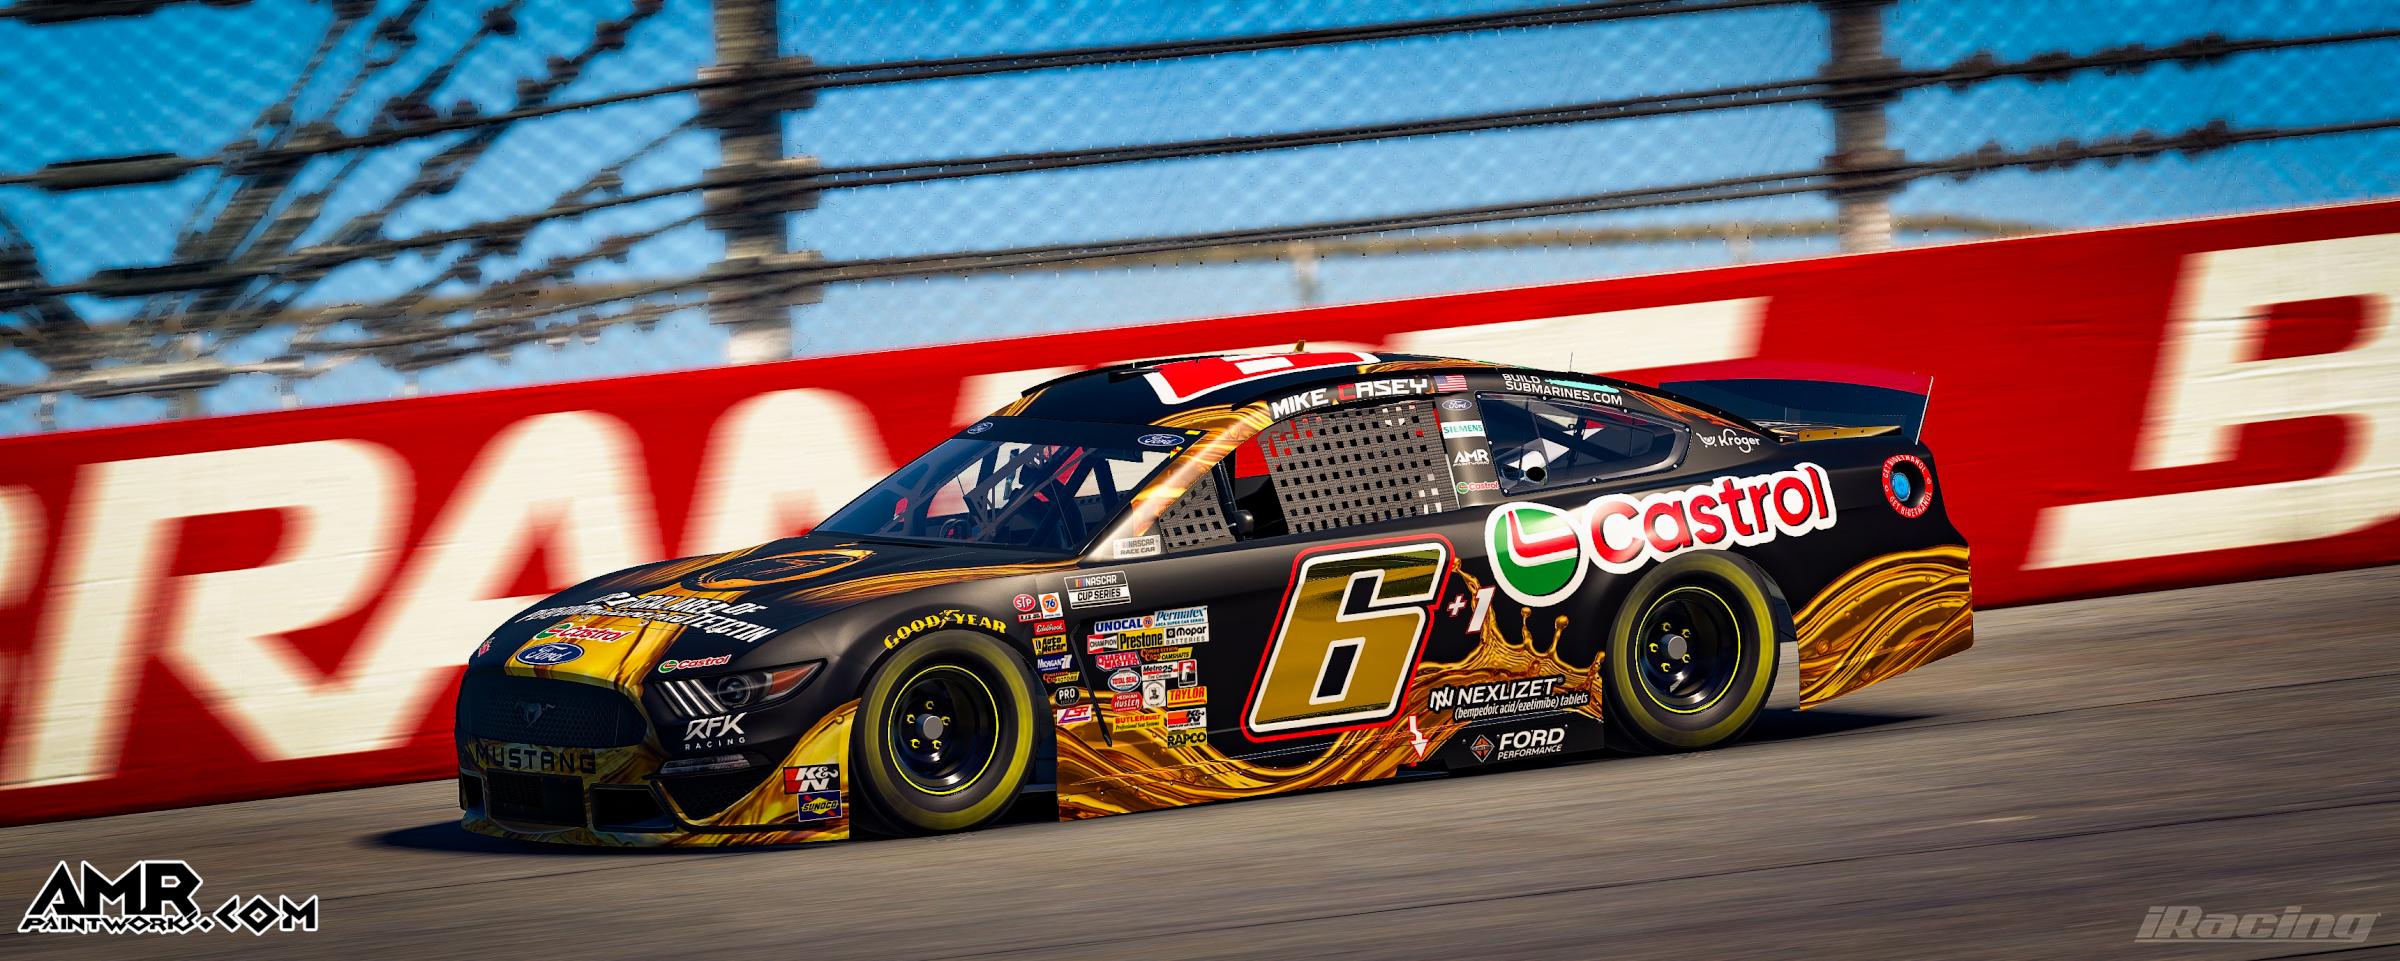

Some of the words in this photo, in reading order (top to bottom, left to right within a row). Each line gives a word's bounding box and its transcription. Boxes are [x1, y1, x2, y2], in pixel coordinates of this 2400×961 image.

[1502, 373, 1542, 384] BUILD
[1271, 388, 1328, 419] MIKE
[1338, 378, 1428, 401] CASEY
[1504, 380, 1623, 406] SUBMARINES.COM
[1443, 424, 1484, 434] SIEMENS
[1718, 428, 1761, 453] Kroger
[1454, 448, 1490, 464] AMR
[1468, 481, 1499, 491] Castrol
[1590, 465, 1829, 564] Castrol
[1128, 538, 1155, 548] NASCAR
[1120, 548, 1140, 556] RACE
[1141, 546, 1155, 554] CAR
[1085, 574, 1118, 587] NASCAR
[1016, 596, 1033, 609] STP
[1077, 589, 1093, 602] CUP
[1094, 588, 1121, 600] SERIES
[1044, 598, 1056, 609] 76
[1156, 607, 1204, 622] Permatex
[1095, 618, 1143, 633] UNOCAL
[556, 625, 635, 643] Castrol
[1119, 631, 1163, 651] Prestone
[1165, 635, 1205, 646] BATTERIES
[1249, 542, 1447, 733] 6
[1089, 639, 1117, 648] CHAMPION
[677, 653, 732, 669] Castrol
[1058, 688, 1076, 701] PRO
[1169, 687, 1205, 701] TAYLOR
[1457, 678, 1556, 706] NEXLIZET
[1454, 702, 1499, 721] (bempedoic
[1500, 697, 1559, 714] acid/ezetimibe)
[1560, 691, 1588, 706] tablets
[683, 712, 748, 740] RFK
[685, 736, 746, 751] RACING
[1167, 732, 1207, 746] RAPCO
[1499, 727, 1565, 751] FORD
[475, 743, 597, 774] MUSTANG
[1497, 743, 1563, 761] PERFORMANCE
[801, 800, 839, 812] SUNOCO
